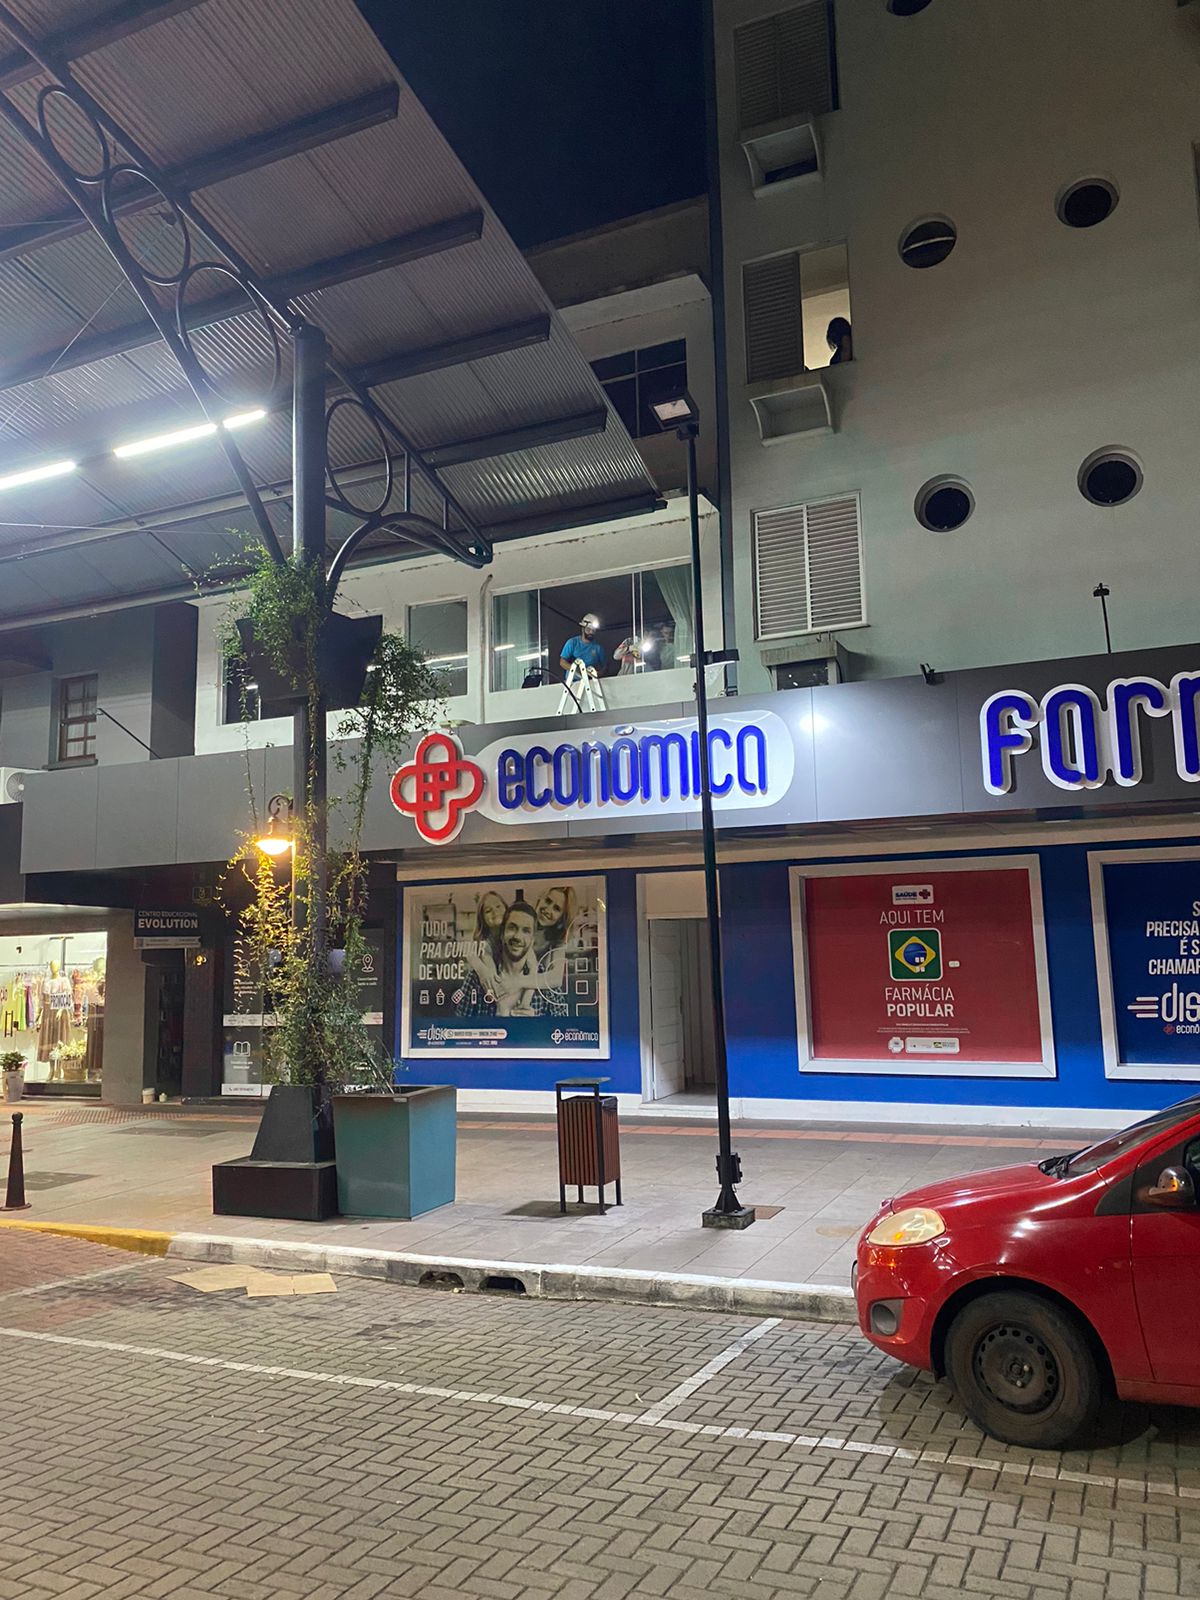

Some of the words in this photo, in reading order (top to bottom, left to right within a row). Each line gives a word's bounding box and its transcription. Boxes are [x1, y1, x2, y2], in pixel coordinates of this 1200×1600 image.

[138, 918, 198, 929] EVOLUTION
[880, 910, 911, 925] AQUI
[914, 909, 945, 924] TEM
[420, 920, 448, 937] TUDO
[1146, 920, 1200, 937] PRECISA
[420, 942, 442, 959] PRA
[444, 940, 487, 958] CUIDAR
[1180, 936, 1188, 955] É
[419, 964, 433, 980] DE
[435, 960, 465, 980] VOCÊ
[884, 983, 955, 1001] FARMÁCIA
[887, 1003, 955, 1017] POPULAR
